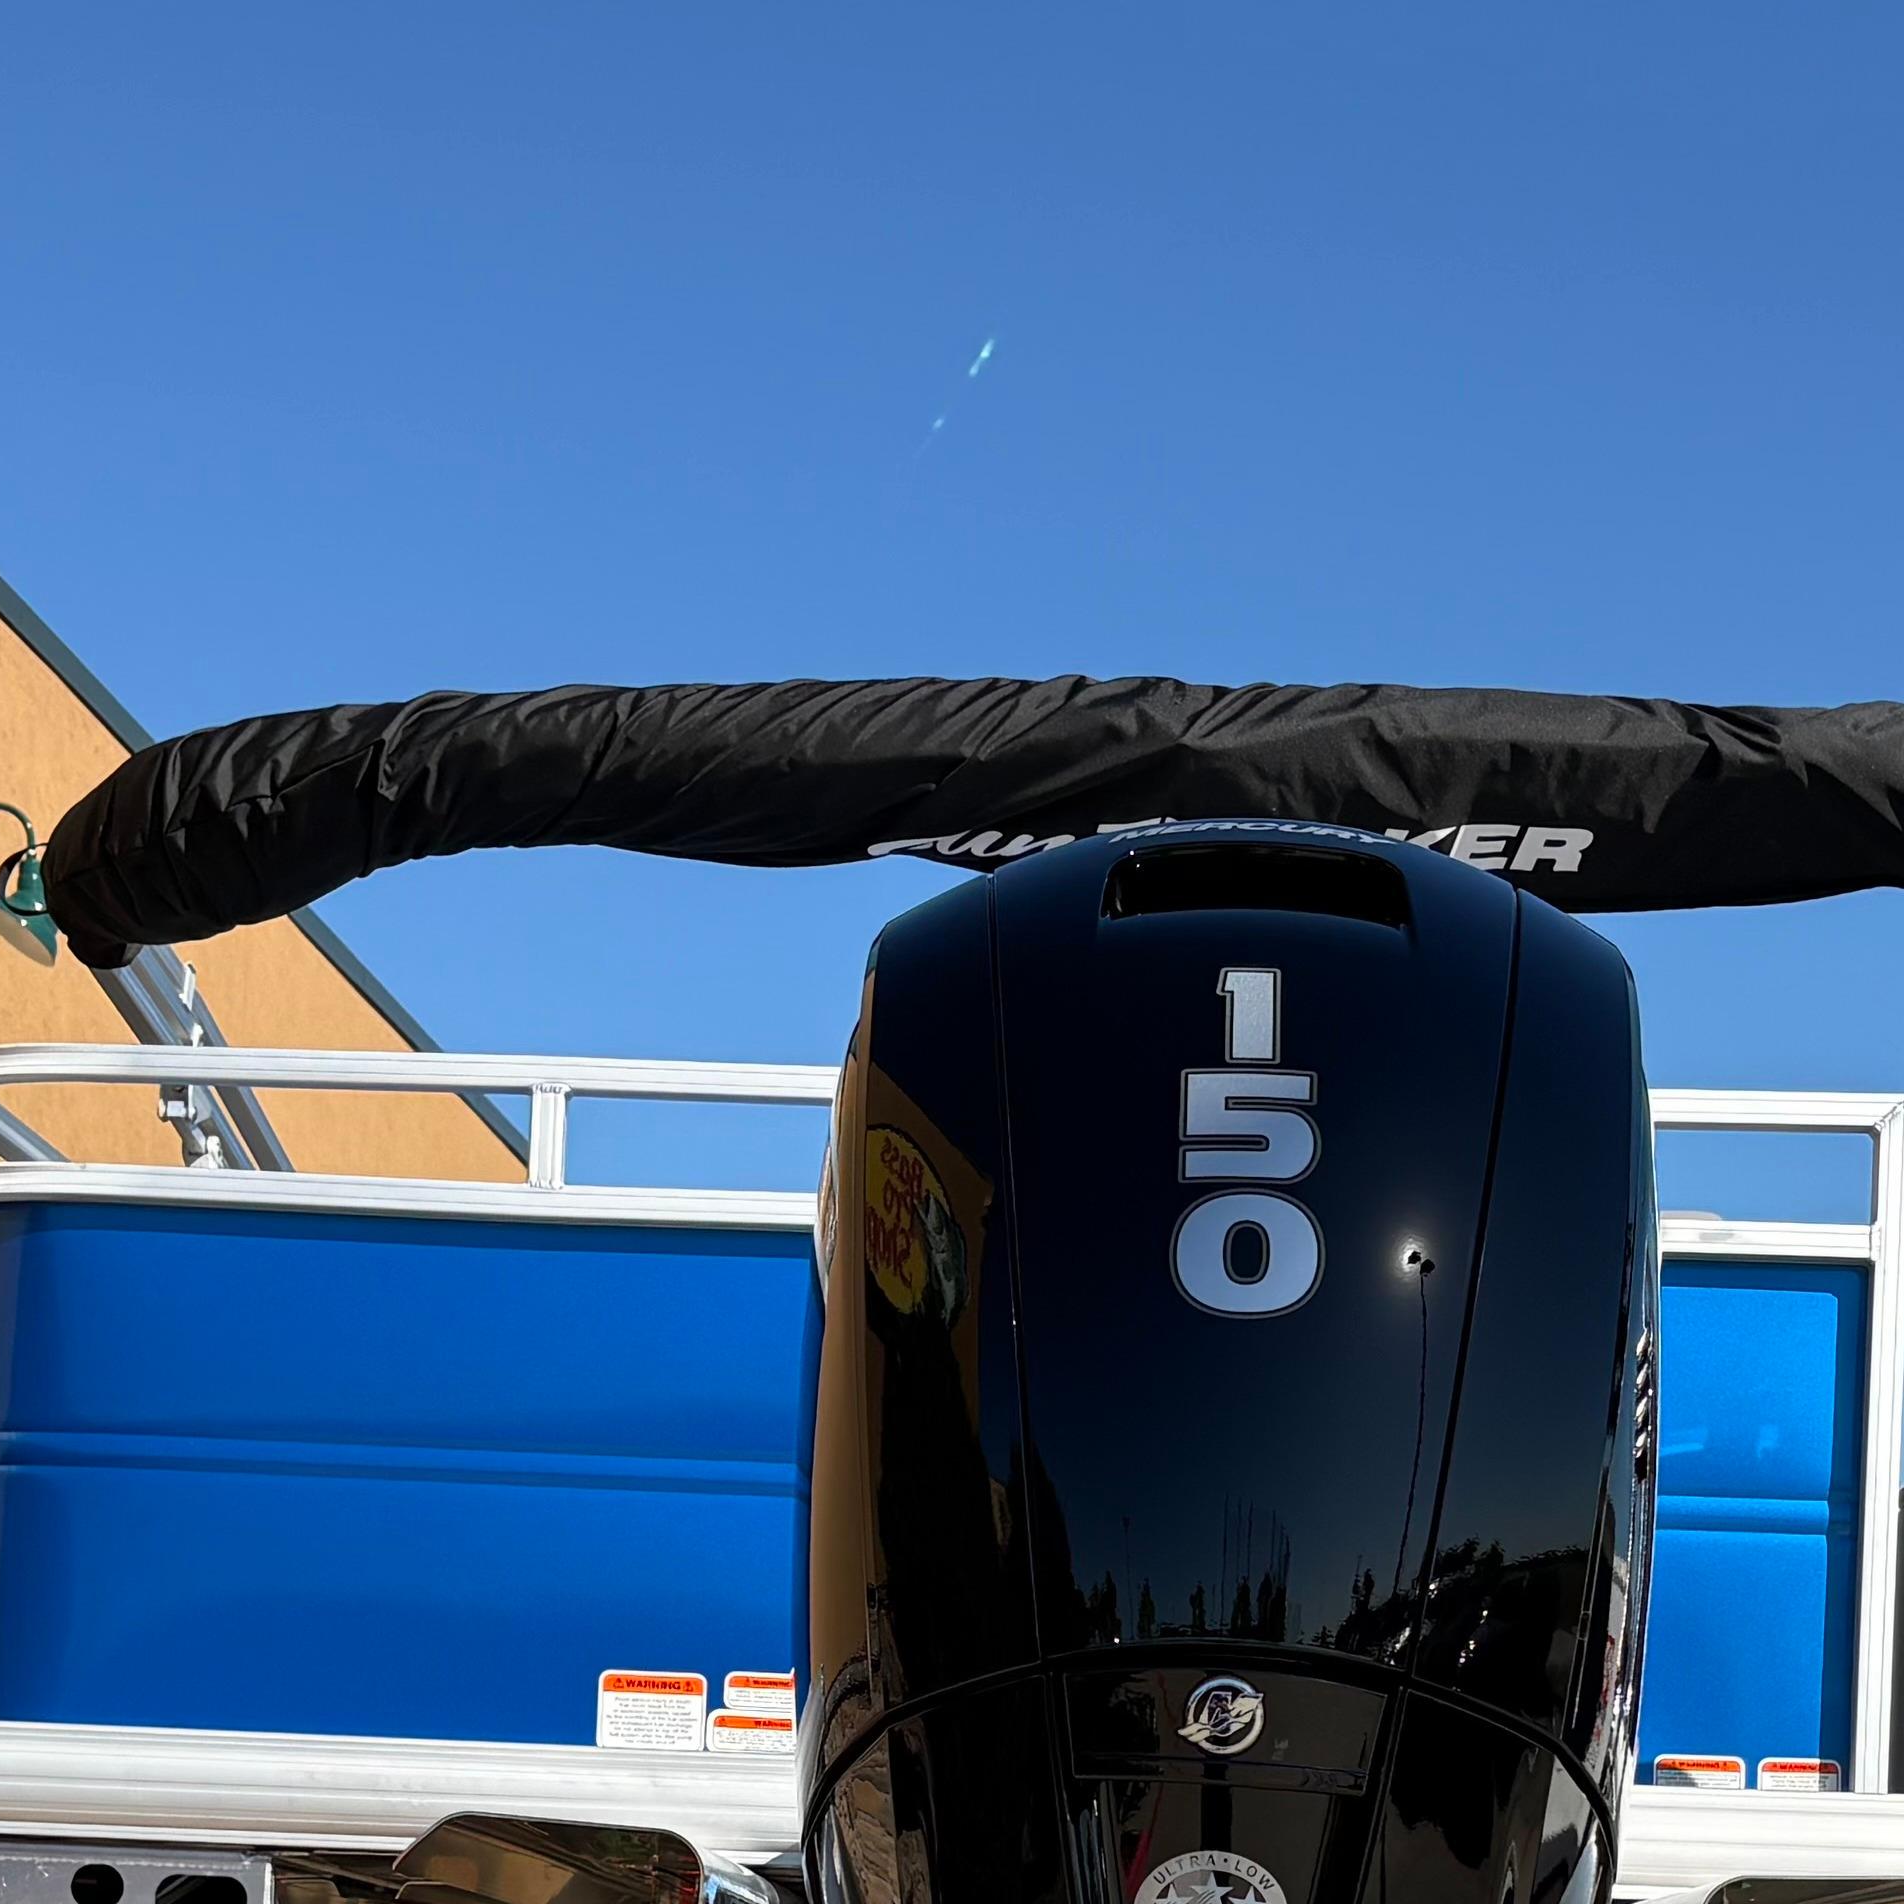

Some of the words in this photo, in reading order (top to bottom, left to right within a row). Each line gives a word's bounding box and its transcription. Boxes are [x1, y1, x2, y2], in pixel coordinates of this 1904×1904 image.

[1109, 822, 1398, 844] MERCURY
[1169, 966, 1326, 1318] 150
[625, 1678, 681, 1691] WARNING
[1153, 1854, 1216, 1885] ULTRA
[1234, 1859, 1275, 1890] LOW
